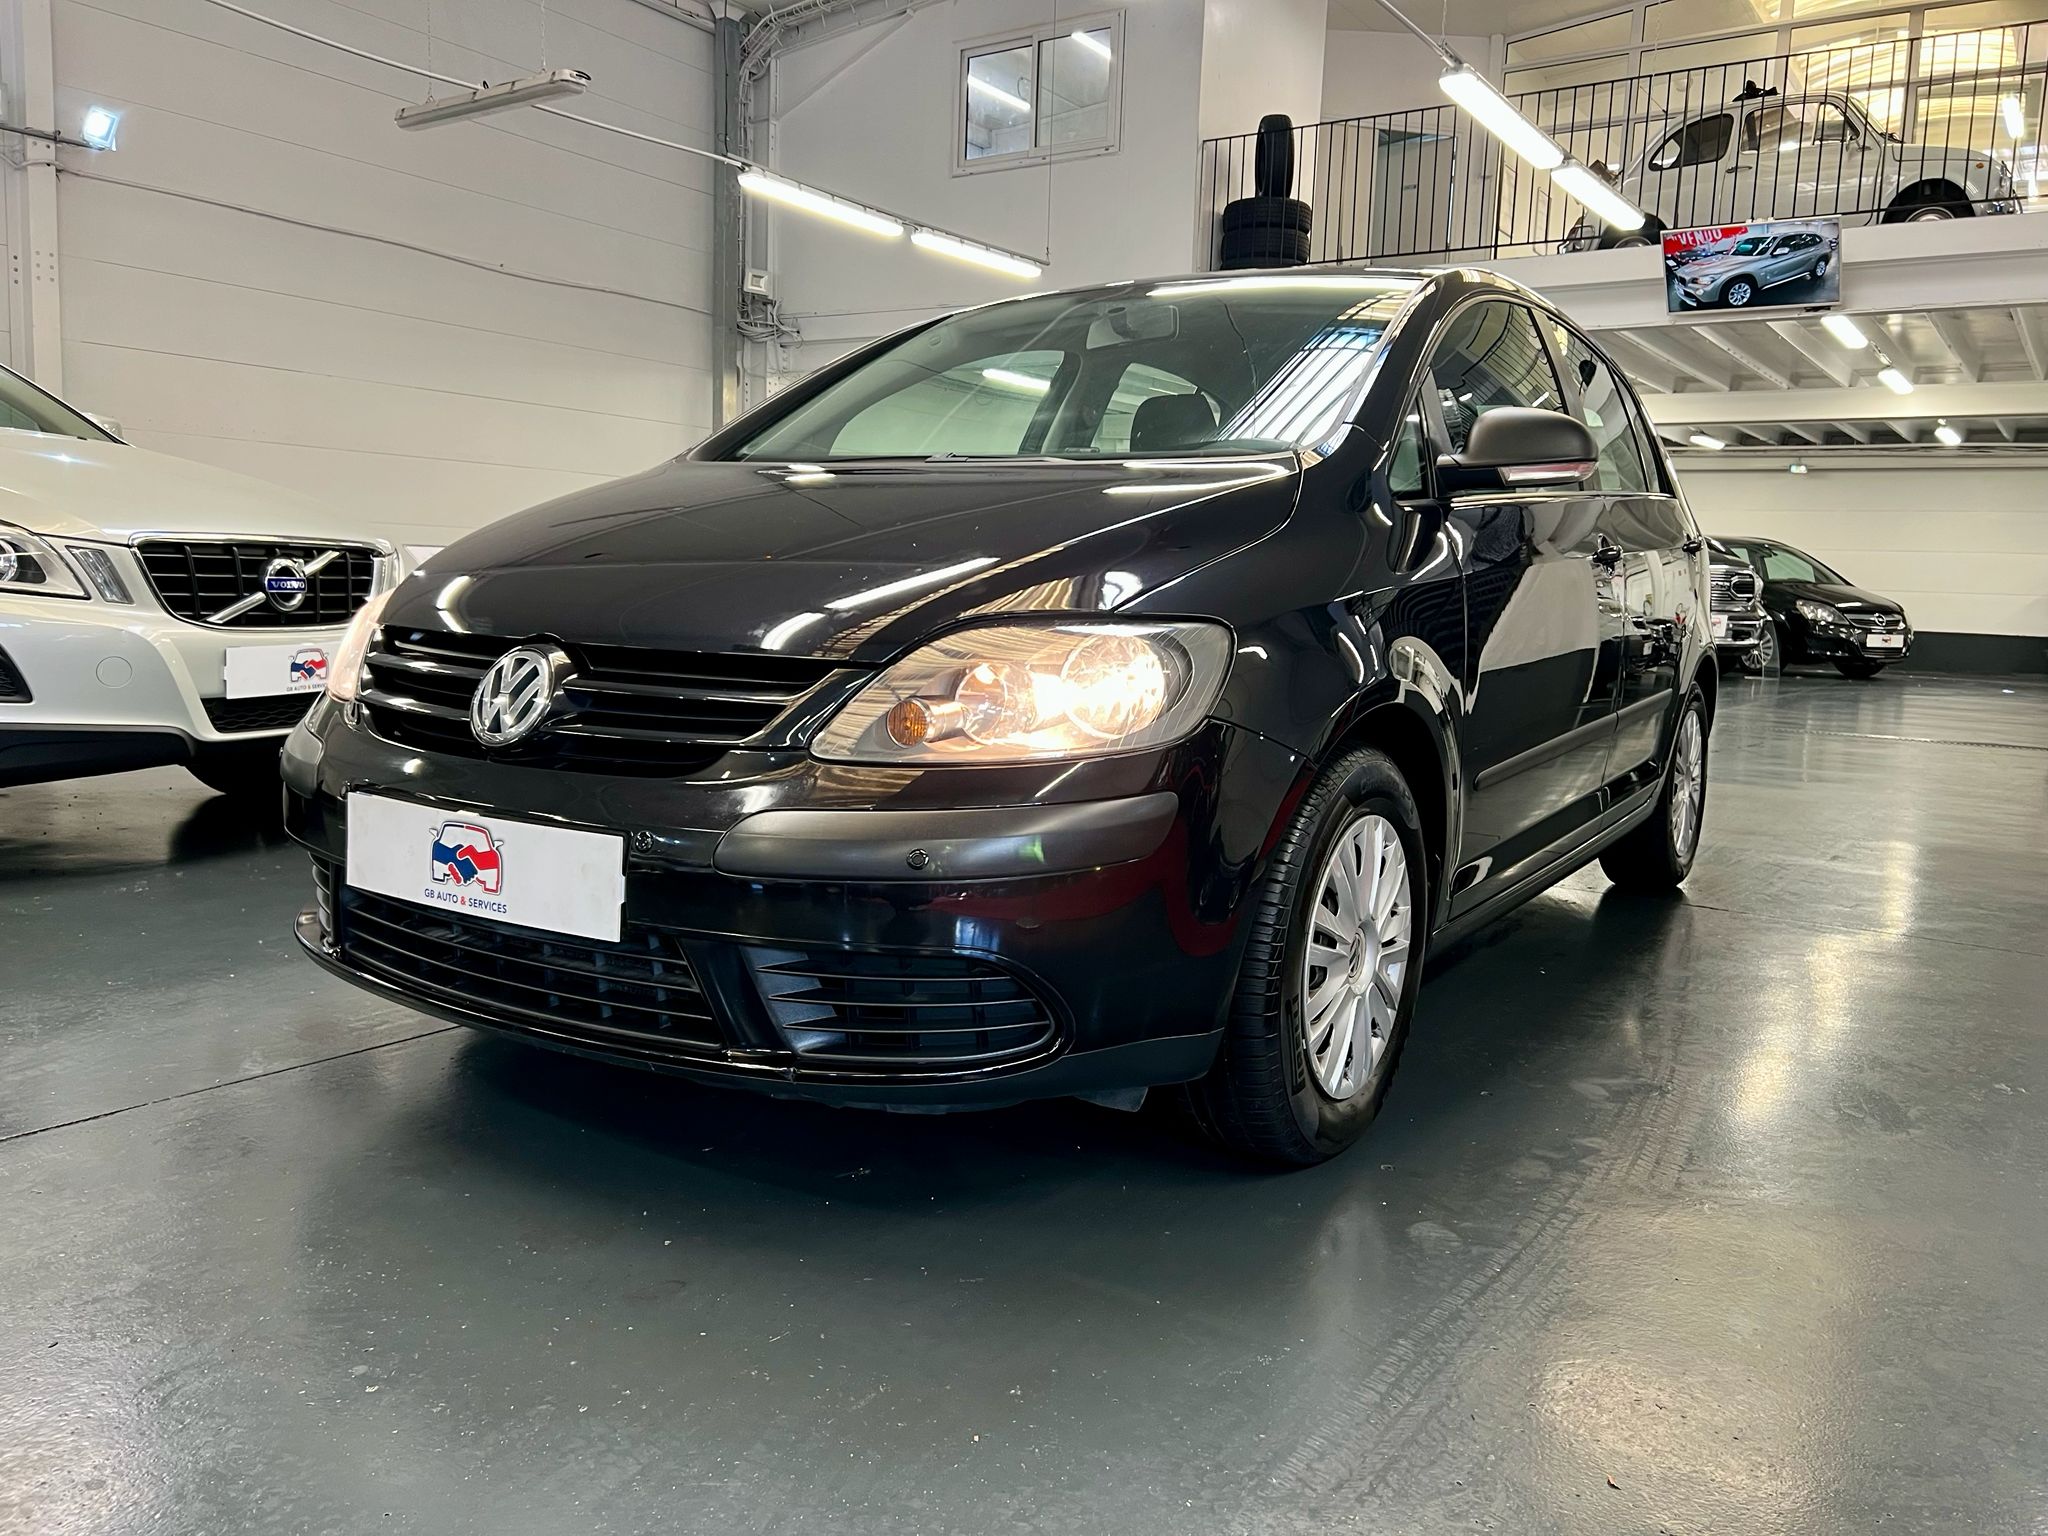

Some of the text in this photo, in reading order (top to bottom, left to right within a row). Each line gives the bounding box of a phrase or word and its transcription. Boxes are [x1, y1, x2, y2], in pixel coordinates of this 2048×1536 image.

[270, 580, 305, 589] VOLVO
[424, 888, 507, 914] GB AUTO & SERVICES
